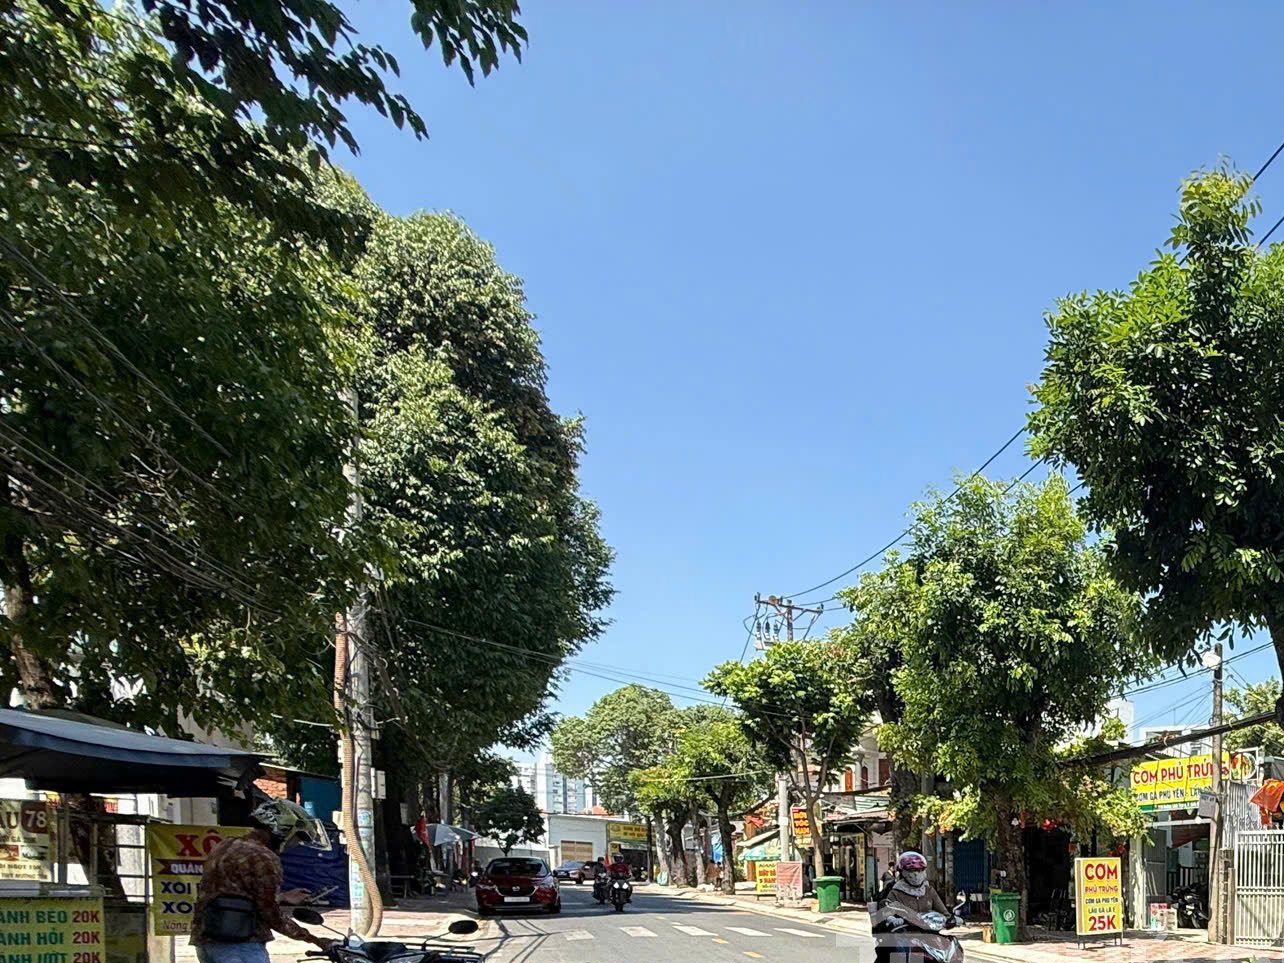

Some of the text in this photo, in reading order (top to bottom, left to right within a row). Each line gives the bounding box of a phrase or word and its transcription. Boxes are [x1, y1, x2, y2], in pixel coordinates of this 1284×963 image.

[24, 809, 48, 829] 78
[175, 828, 222, 857] XÔ
[1085, 863, 1118, 881] CƠM
[0, 908, 30, 924] ÁNH
[72, 909, 100, 923] 20K
[1088, 915, 1117, 932] 25K
[0, 929, 31, 946] ÁNH
[72, 931, 100, 944] 20K
